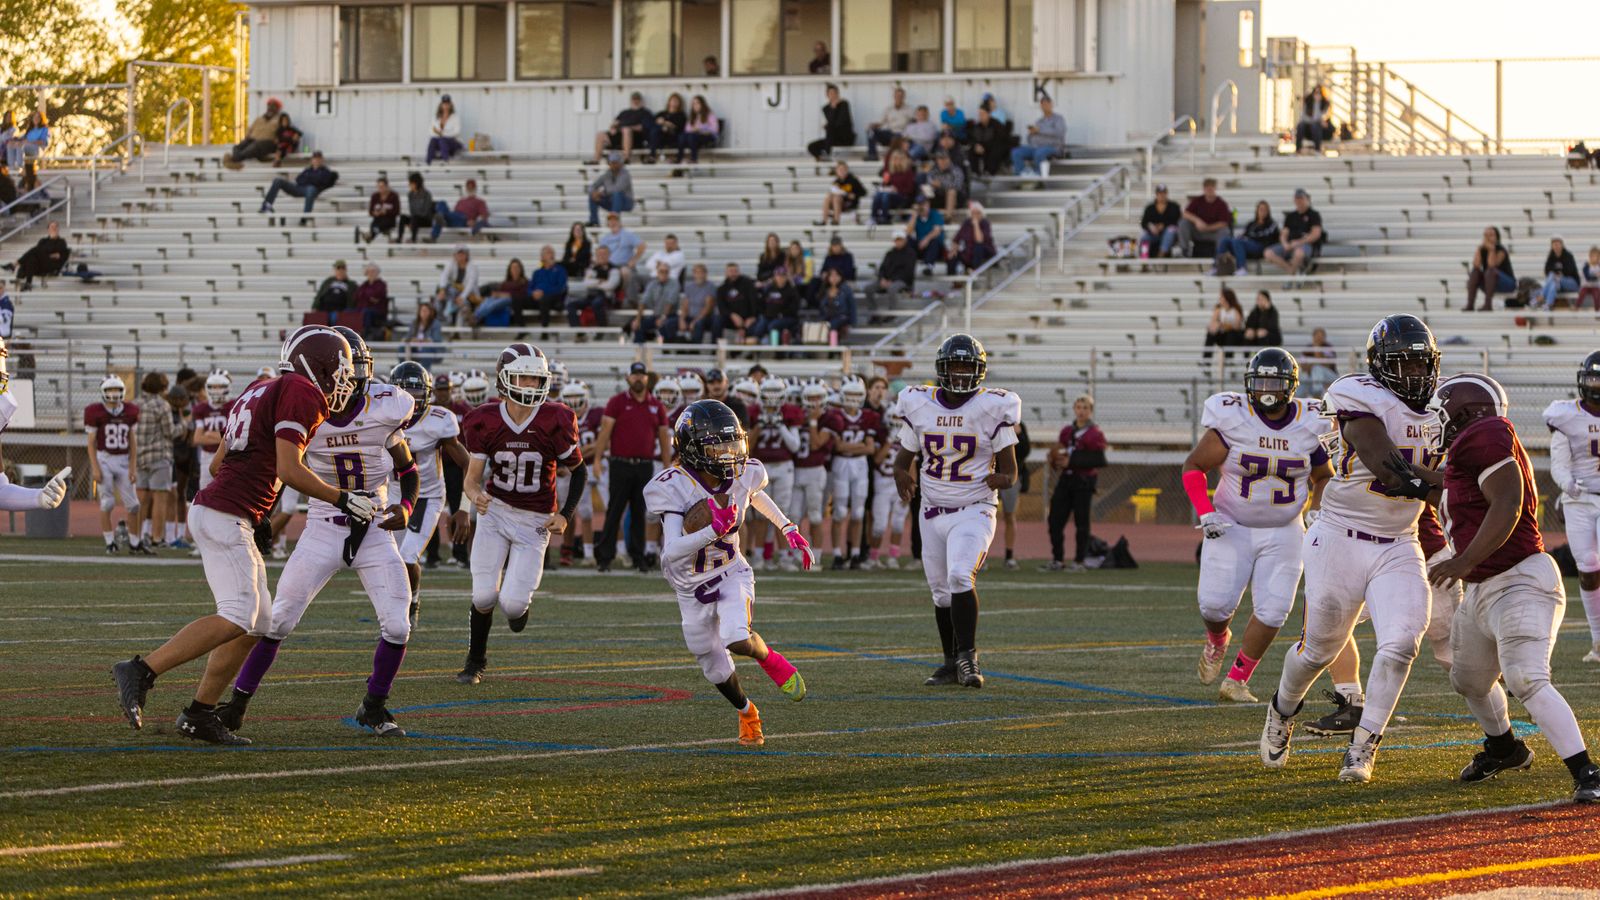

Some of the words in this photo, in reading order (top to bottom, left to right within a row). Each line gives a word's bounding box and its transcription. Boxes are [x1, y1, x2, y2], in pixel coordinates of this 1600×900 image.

[316, 90, 332, 114] H
[584, 85, 589, 110] I
[767, 82, 781, 107] J
[1034, 78, 1050, 102] K
[937, 416, 964, 427] ELITE
[105, 423, 130, 449] 80
[326, 434, 359, 448] ELITE
[1259, 436, 1289, 451] ELITE
[922, 432, 978, 482] 62
[493, 451, 543, 493] 30
[1238, 452, 1306, 506] 75
